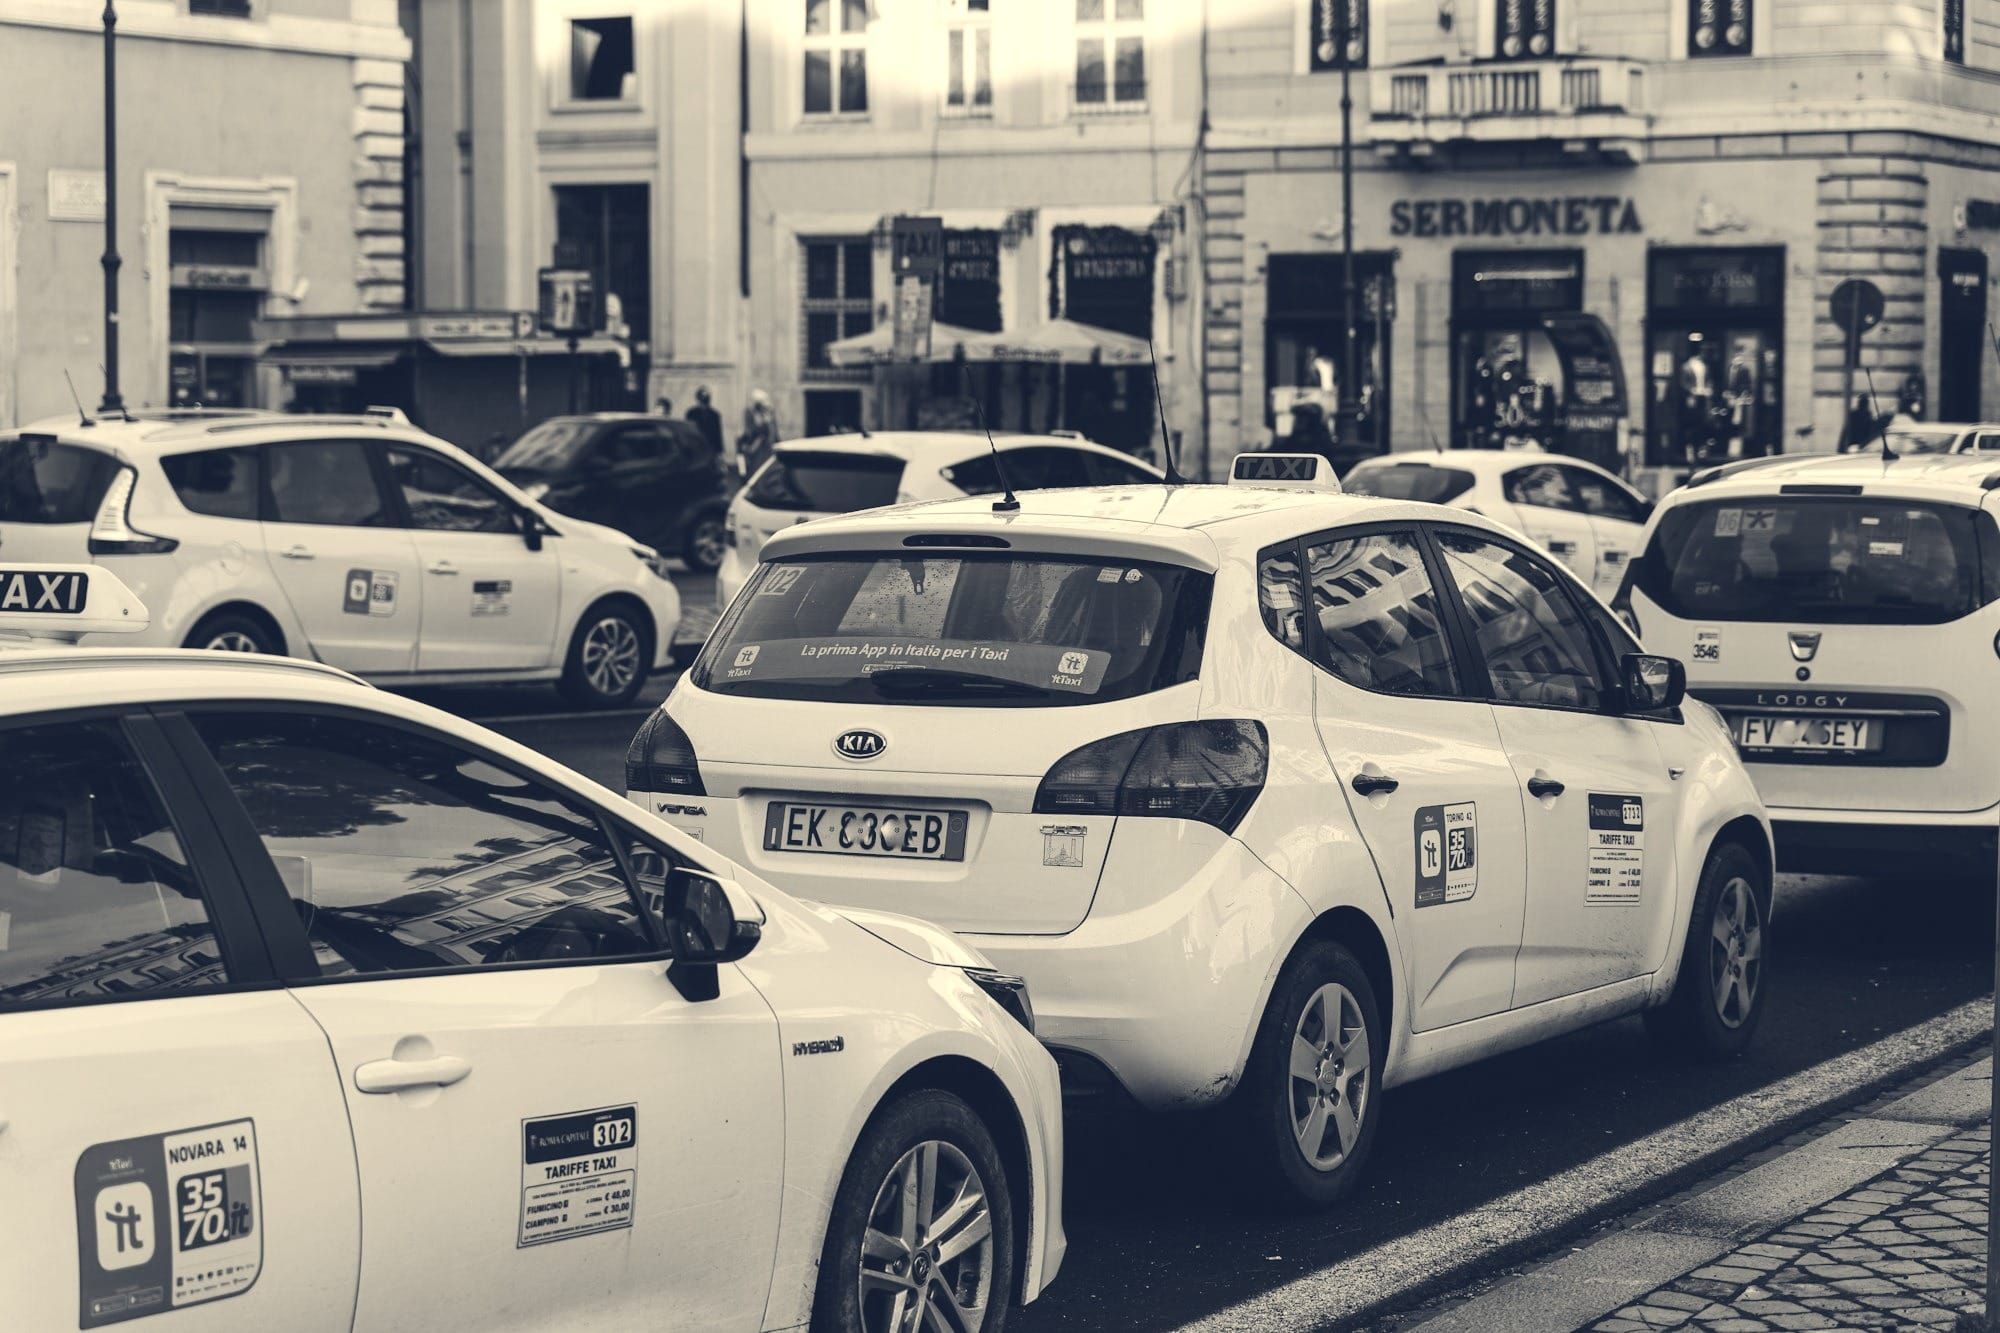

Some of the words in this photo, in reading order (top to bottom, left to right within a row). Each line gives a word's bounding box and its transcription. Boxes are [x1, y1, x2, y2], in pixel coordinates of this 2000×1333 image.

[1390, 195, 1642, 237] SERMONETA
[1239, 458, 1313, 479] TAXI
[1718, 511, 1737, 531] 06
[764, 569, 800, 593] 02
[801, 644, 817, 657] La
[817, 644, 857, 659] prima
[858, 643, 887, 659] App
[889, 644, 904, 656] in
[905, 644, 940, 658] Italia
[942, 647, 968, 660] per
[970, 647, 977, 658] i
[979, 647, 1010, 661] Taxi
[1693, 643, 1719, 659] 3546
[1757, 694, 1848, 707] LODGY
[843, 735, 877, 751] KIA
[656, 802, 708, 817] VENGA
[1446, 812, 1465, 823] TORINO
[786, 807, 827, 847] EK
[1450, 830, 1466, 851] 35
[1599, 834, 1621, 845] TARIFFE
[1622, 835, 1635, 845] TAXI
[792, 1035, 844, 1056] HYBRID
[597, 1121, 629, 1145] 302
[169, 1139, 225, 1164] NOVARA
[233, 1135, 247, 1151] 14
[545, 1160, 590, 1179] TARIFFE
[593, 1156, 617, 1171] TAXI
[182, 1175, 223, 1213] 35
[527, 1201, 563, 1214] FIUMICINO
[525, 1215, 559, 1230] CIAMPINO
